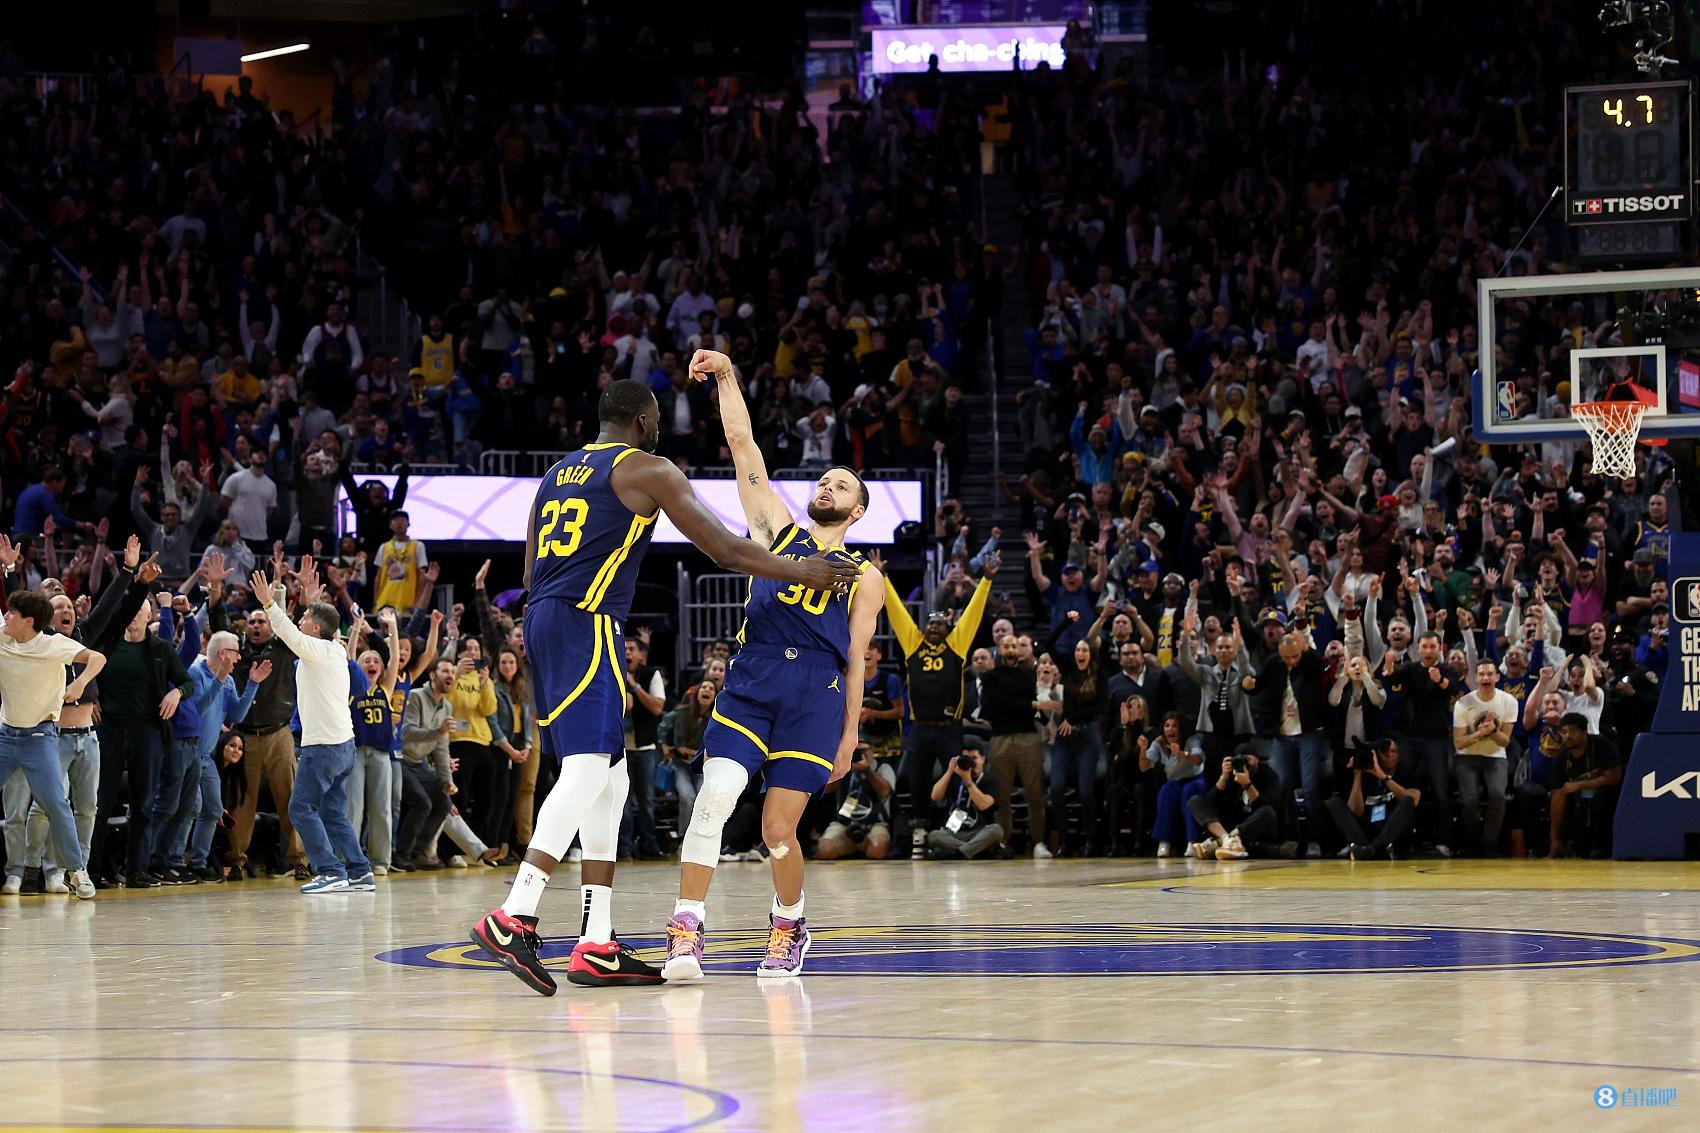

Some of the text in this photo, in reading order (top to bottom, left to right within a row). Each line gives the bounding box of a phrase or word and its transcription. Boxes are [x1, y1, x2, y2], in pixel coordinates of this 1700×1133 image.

[887, 41, 935, 64] Get
[1603, 95, 1653, 127] 4.7
[1603, 195, 1684, 213] TISSOT
[556, 465, 595, 487] GREEN
[537, 497, 590, 561] 23
[923, 656, 944, 672] 30
[364, 707, 383, 724] 30
